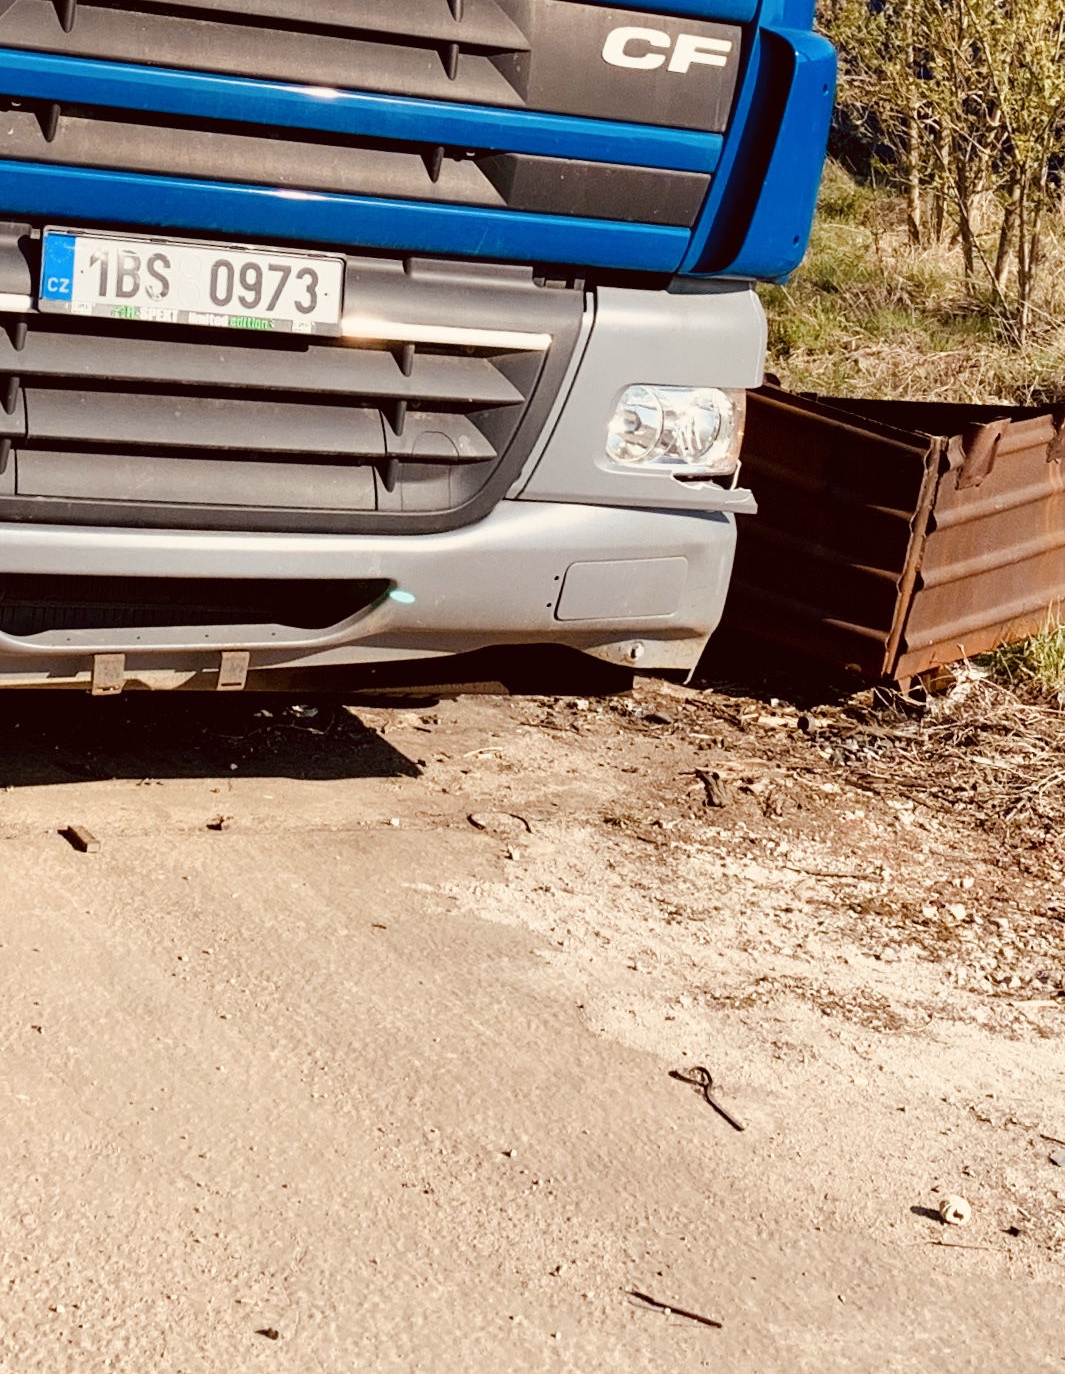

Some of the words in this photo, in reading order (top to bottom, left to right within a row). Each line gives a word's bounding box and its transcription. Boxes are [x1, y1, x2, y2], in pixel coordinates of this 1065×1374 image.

[601, 26, 733, 74] CF
[46, 276, 70, 294] CZ
[90, 248, 171, 302] 1BS
[209, 258, 320, 315] 0973
[188, 311, 229, 327] limited
[230, 316, 269, 329] edition
